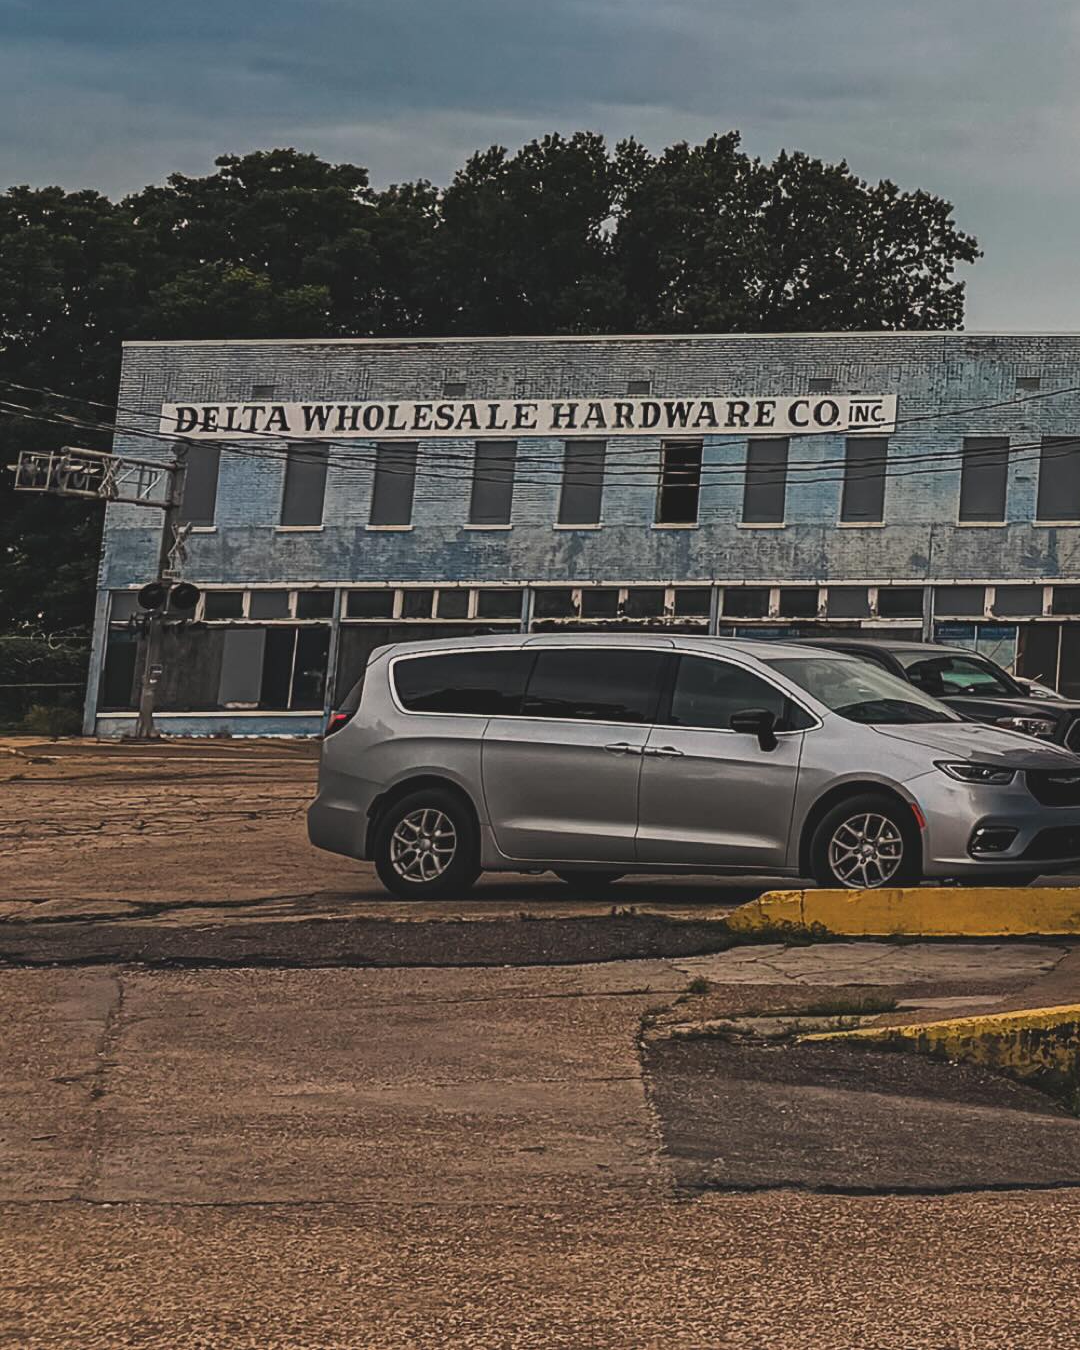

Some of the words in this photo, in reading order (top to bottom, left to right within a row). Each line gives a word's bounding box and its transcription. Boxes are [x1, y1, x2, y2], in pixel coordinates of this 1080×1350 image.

[174, 404, 291, 433] DELTA
[301, 402, 538, 432] WHOLESALE
[551, 399, 777, 429] HARDWARE
[788, 399, 841, 427] CO.
[849, 403, 886, 423] INC.
